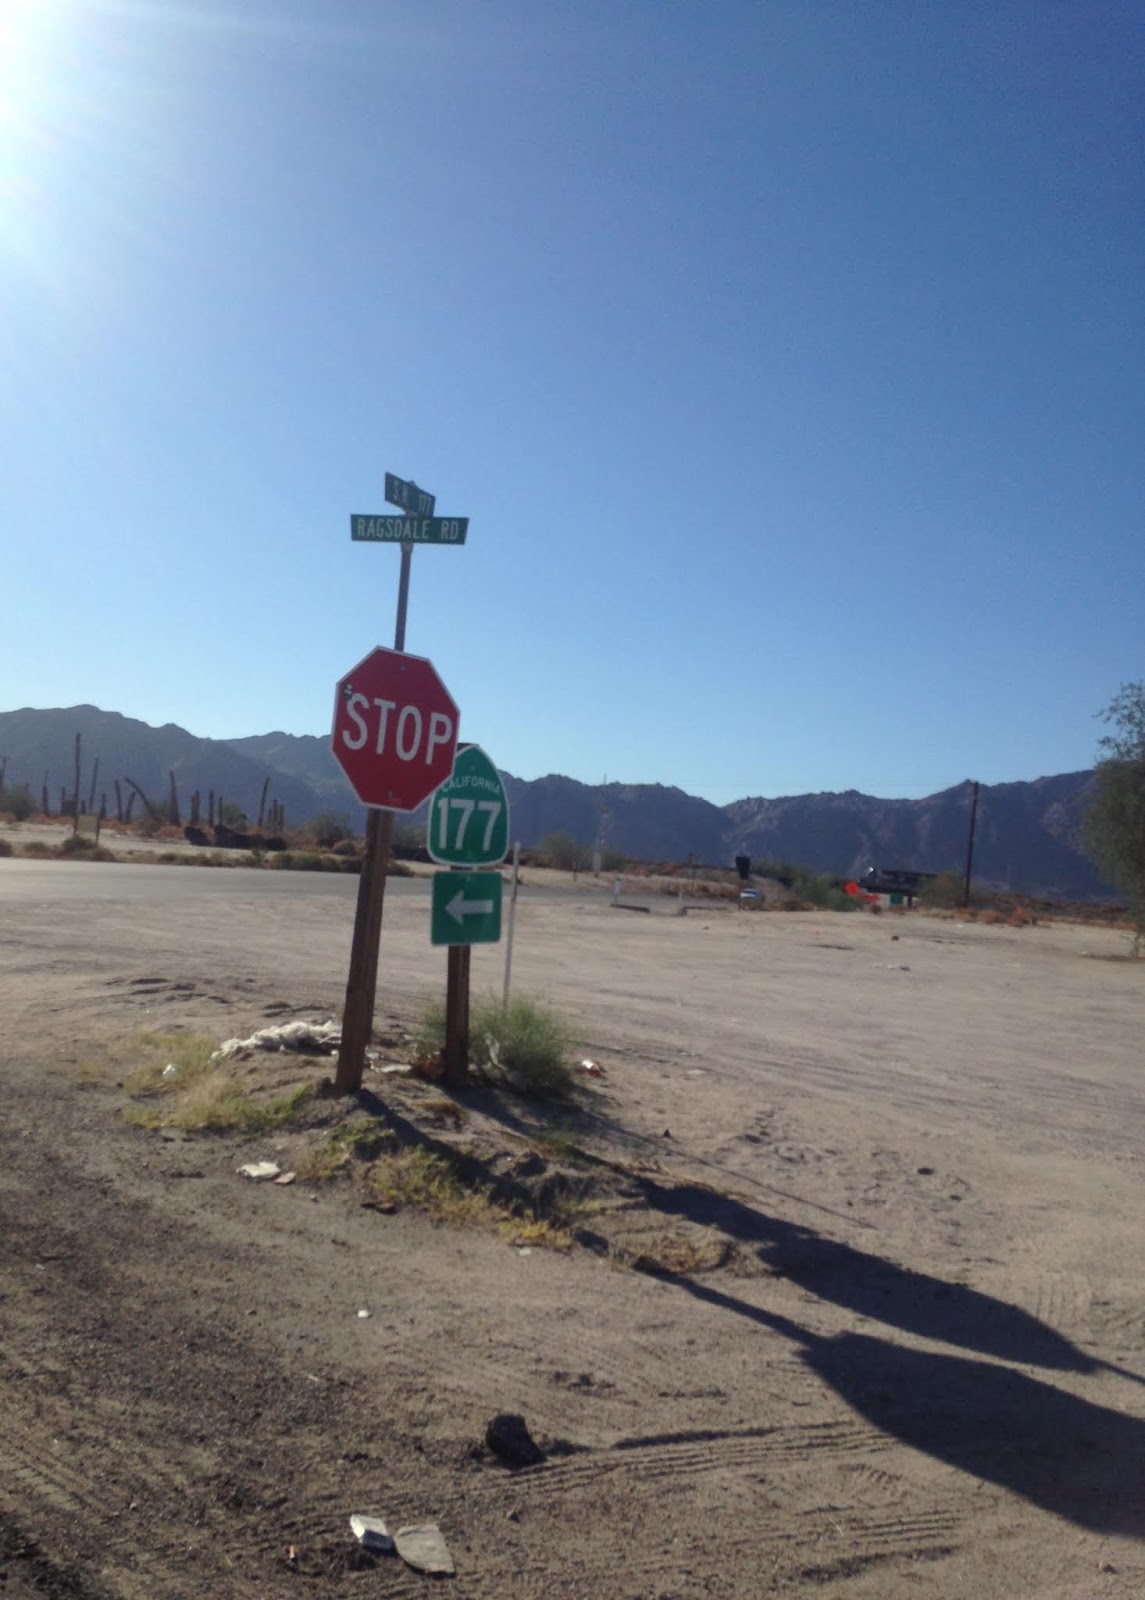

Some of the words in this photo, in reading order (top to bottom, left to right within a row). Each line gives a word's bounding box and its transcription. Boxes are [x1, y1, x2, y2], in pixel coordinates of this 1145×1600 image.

[357, 518, 431, 540] RAGSDALE
[440, 520, 459, 540] RD
[342, 692, 453, 765] STOP
[438, 797, 502, 852] 177
